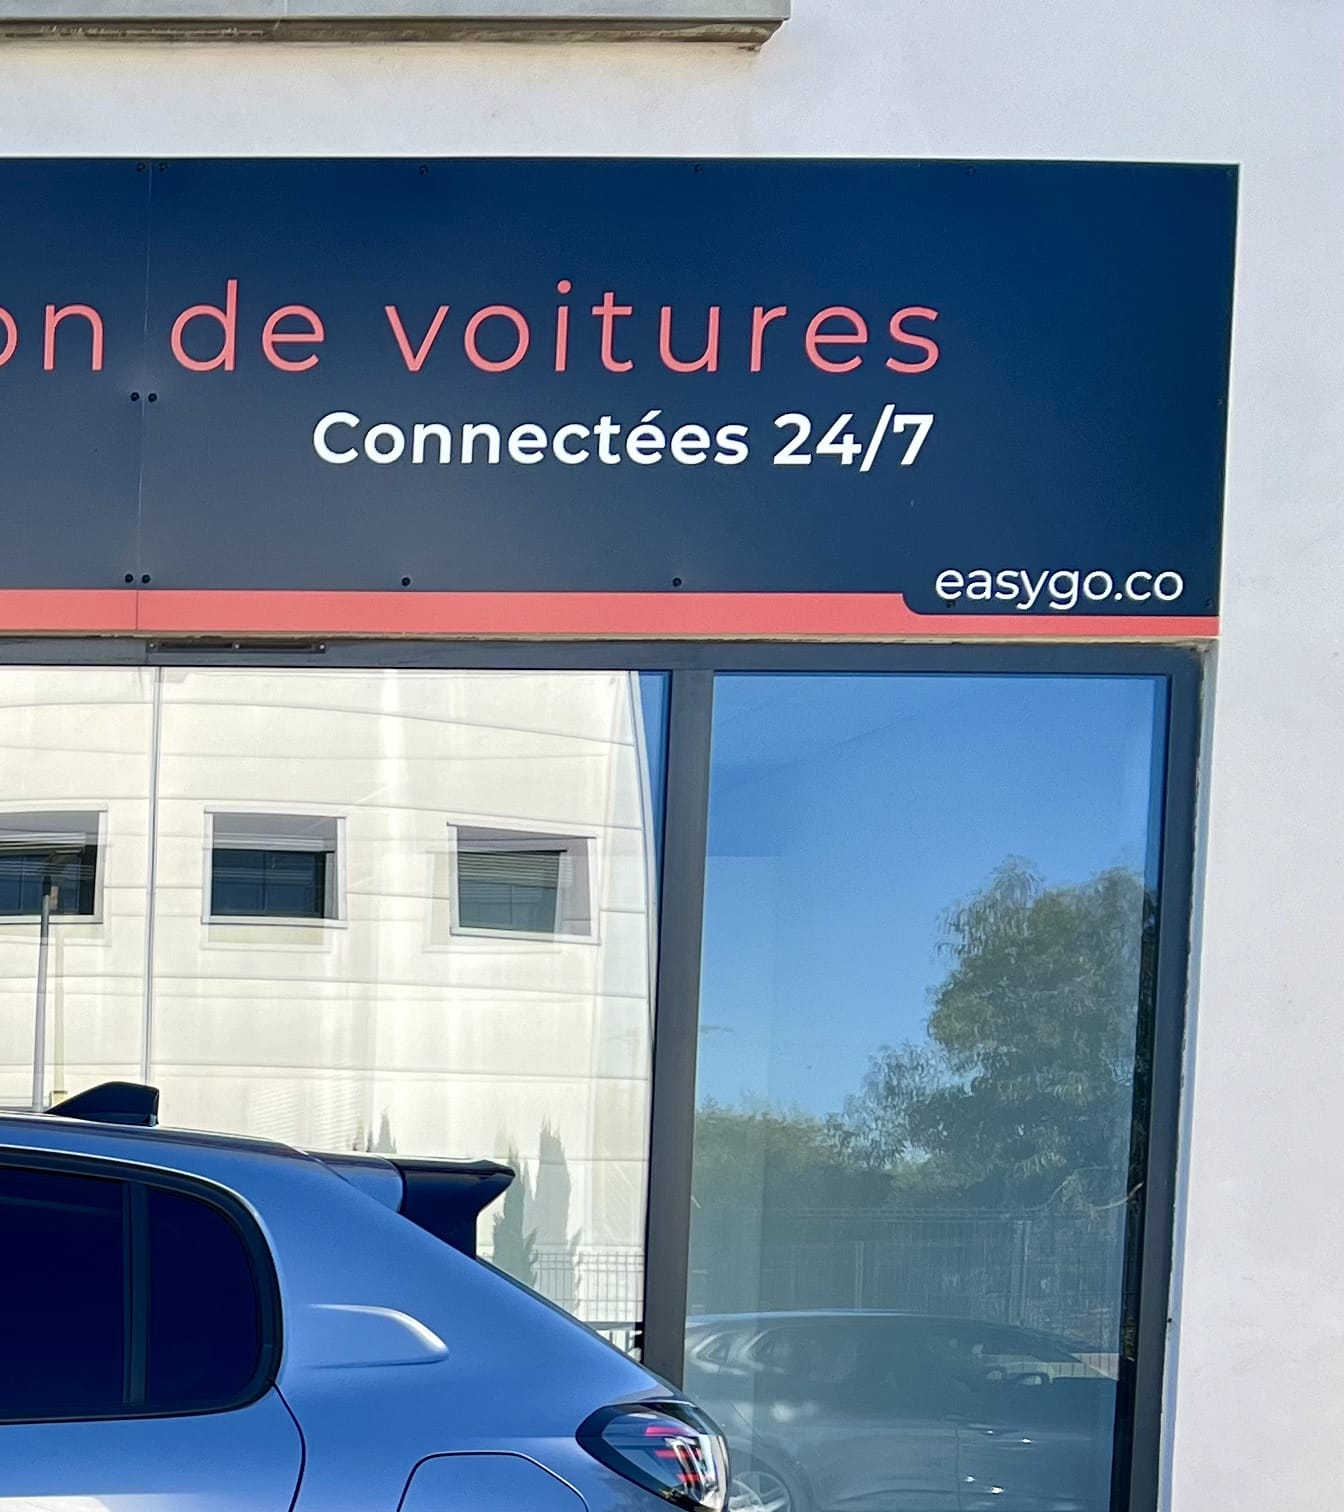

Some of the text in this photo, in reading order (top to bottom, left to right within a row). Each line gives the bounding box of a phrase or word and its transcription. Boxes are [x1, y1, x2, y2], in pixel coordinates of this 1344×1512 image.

[170, 279, 326, 373] de
[385, 280, 940, 374] voitures
[313, 403, 934, 472] Connectées 24/7
[935, 569, 1184, 610] easygo.co
